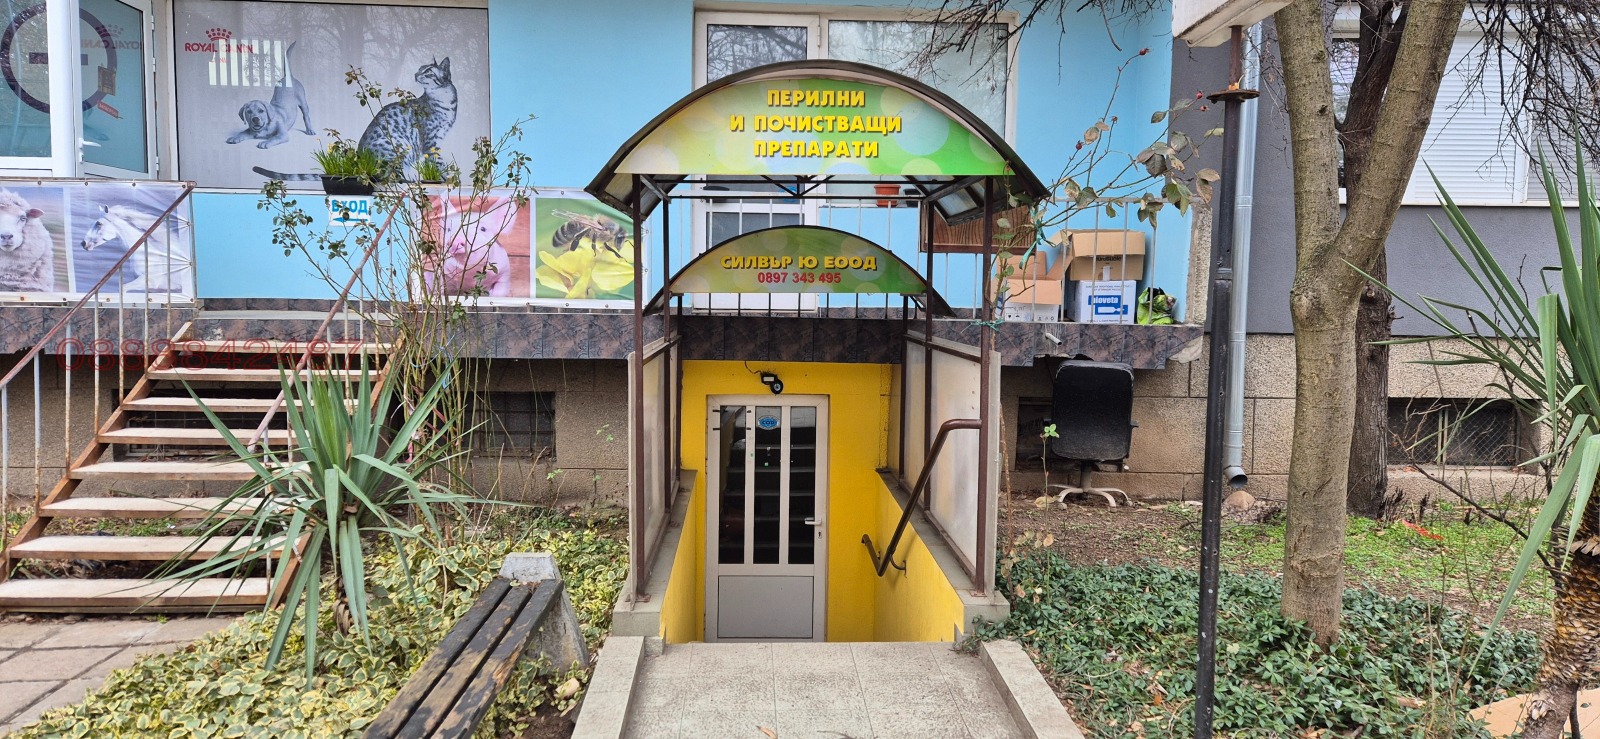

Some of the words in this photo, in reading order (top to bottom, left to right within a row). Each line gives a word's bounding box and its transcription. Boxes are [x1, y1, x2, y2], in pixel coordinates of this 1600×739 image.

[184, 42, 218, 53] ROYAL
[767, 89, 866, 107] ПЕРИЛНИ
[729, 114, 745, 132] И
[754, 114, 903, 136] ПОЧИСТВАЩИ
[753, 140, 879, 158] ПРЕПАРАТИ
[720, 255, 793, 270] СИЛВЪР
[798, 255, 819, 270] Ю
[824, 256, 878, 271] ЕООД
[757, 272, 788, 284] 0897
[792, 272, 815, 284] 343
[818, 272, 842, 284] 495
